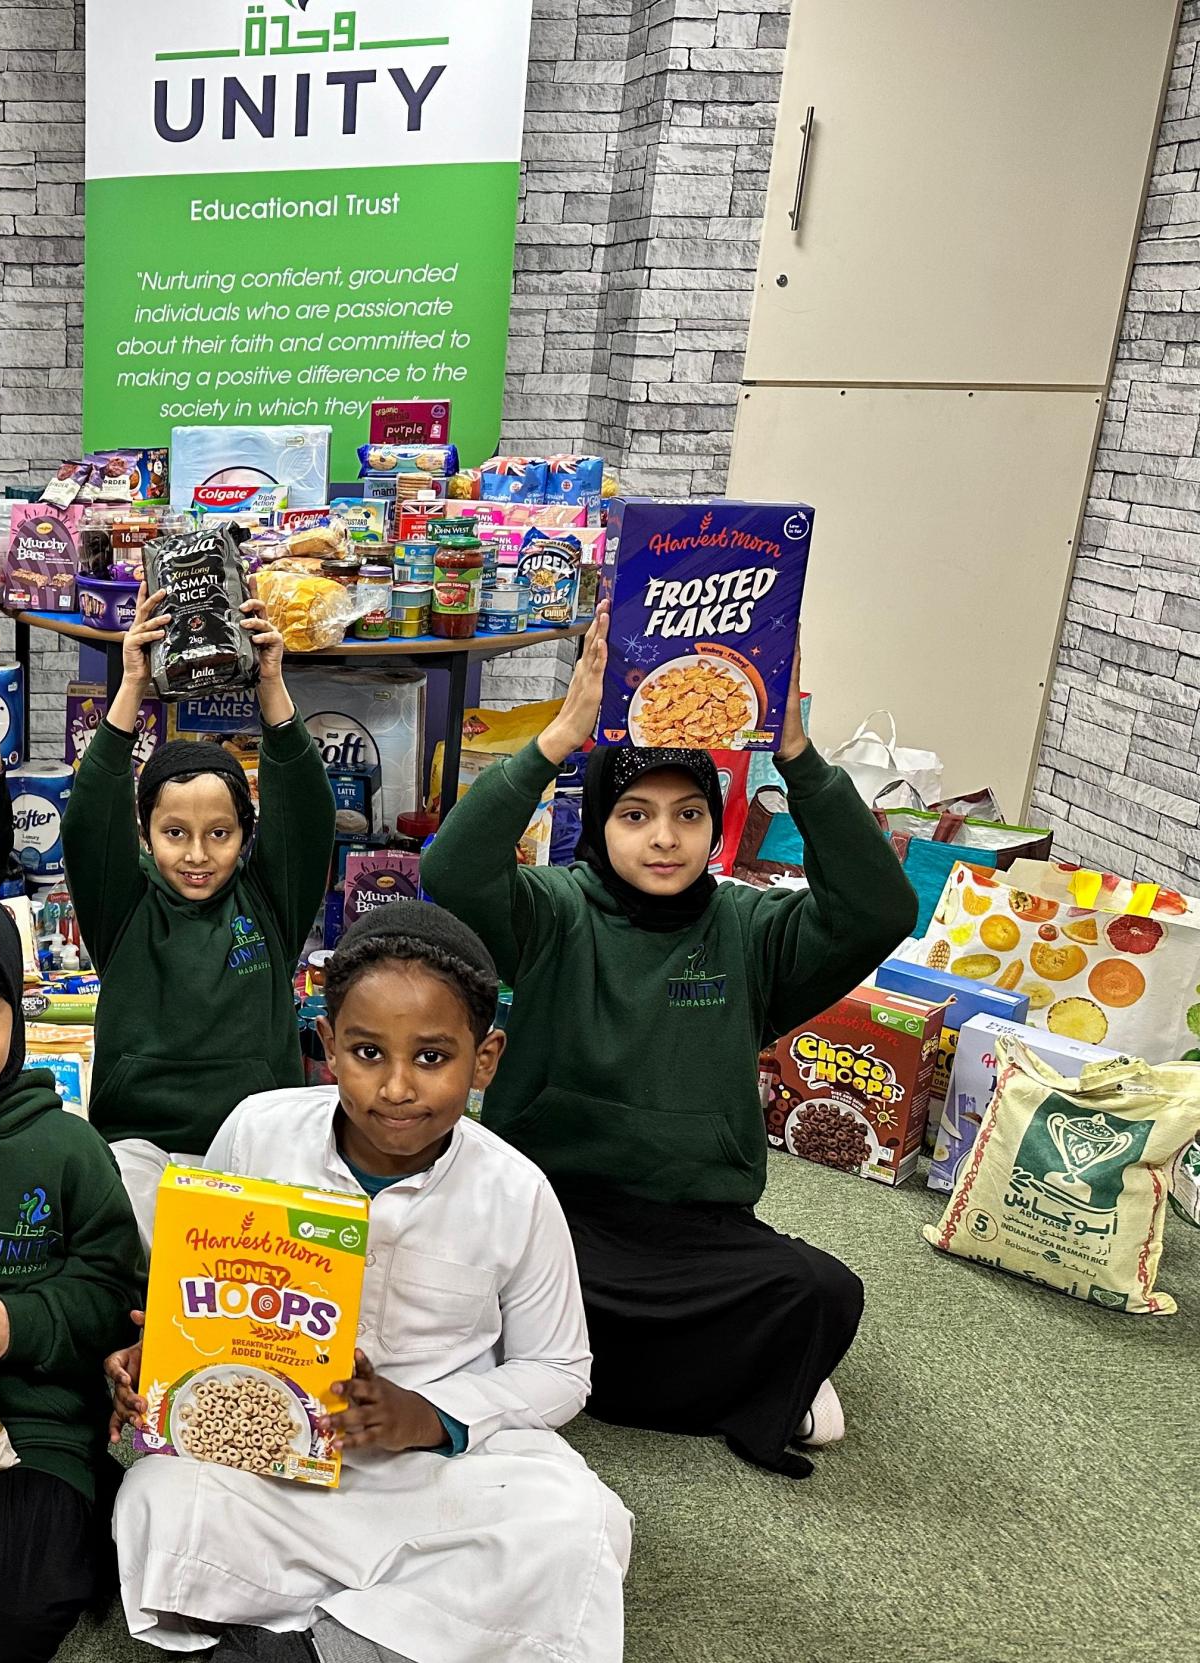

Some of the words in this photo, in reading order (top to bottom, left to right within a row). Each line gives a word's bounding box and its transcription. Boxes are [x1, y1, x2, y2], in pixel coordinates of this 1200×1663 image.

[154, 65, 447, 143] UNITY
[190, 196, 338, 222] Educational
[346, 193, 400, 216] Trust
[242, 266, 345, 290] confident,
[349, 263, 458, 288] grounded
[134, 301, 240, 323] individuals
[246, 301, 290, 321] who
[295, 304, 330, 320] are
[333, 299, 454, 323] passionate
[116, 334, 177, 356] about
[181, 334, 226, 354] their
[229, 333, 274, 353] faith
[279, 331, 322, 353] and
[327, 330, 446, 353] committed
[450, 331, 471, 349] to
[116, 366, 191, 390] making
[196, 371, 211, 387] a
[215, 365, 293, 388] positive
[297, 362, 402, 385] difference
[406, 365, 427, 382] to
[431, 362, 467, 381] the
[159, 401, 228, 421] society
[233, 401, 255, 416] in
[259, 398, 320, 415] which
[324, 397, 369, 418] they
[375, 406, 398, 416] organic
[387, 423, 423, 437] purple
[198, 489, 248, 501] Colgate
[19, 537, 68, 553] Munchy
[121, 533, 131, 543] 16
[648, 528, 729, 556] Harvest
[730, 529, 782, 558] Morn
[17, 548, 45, 561] Bars
[522, 552, 573, 576] SUPER
[191, 566, 210, 575] Long
[166, 575, 218, 594] BASMATI
[643, 566, 777, 609] FROSTED
[179, 590, 207, 603] RICE
[644, 601, 755, 639] FLAKES
[191, 667, 215, 680] Laila
[187, 702, 253, 717] FLAKES
[337, 788, 355, 796] LATTE
[668, 980, 726, 999] UNITY
[669, 997, 725, 1007] MADRASSAH
[798, 1037, 887, 1081] Choco
[816, 1062, 893, 1098] Hoops
[974, 1214, 989, 1232] 5
[1019, 1209, 1039, 1220] ABU
[1042, 1219, 1068, 1232] KASS
[186, 1228, 273, 1251] Harvest
[274, 1236, 333, 1273] Morn
[1001, 1224, 1026, 1237] INDIAN
[1028, 1234, 1054, 1249] MAZZA
[1056, 1245, 1090, 1261] BASMATI
[1091, 1256, 1108, 1266] RICE
[1005, 1240, 1040, 1257] Babaker
[217, 1262, 287, 1286] HONEY
[185, 1281, 337, 1336] HOOPS
[232, 1339, 275, 1350] BREAKFAST
[277, 1343, 297, 1356] WITH
[149, 1436, 159, 1444] 12
